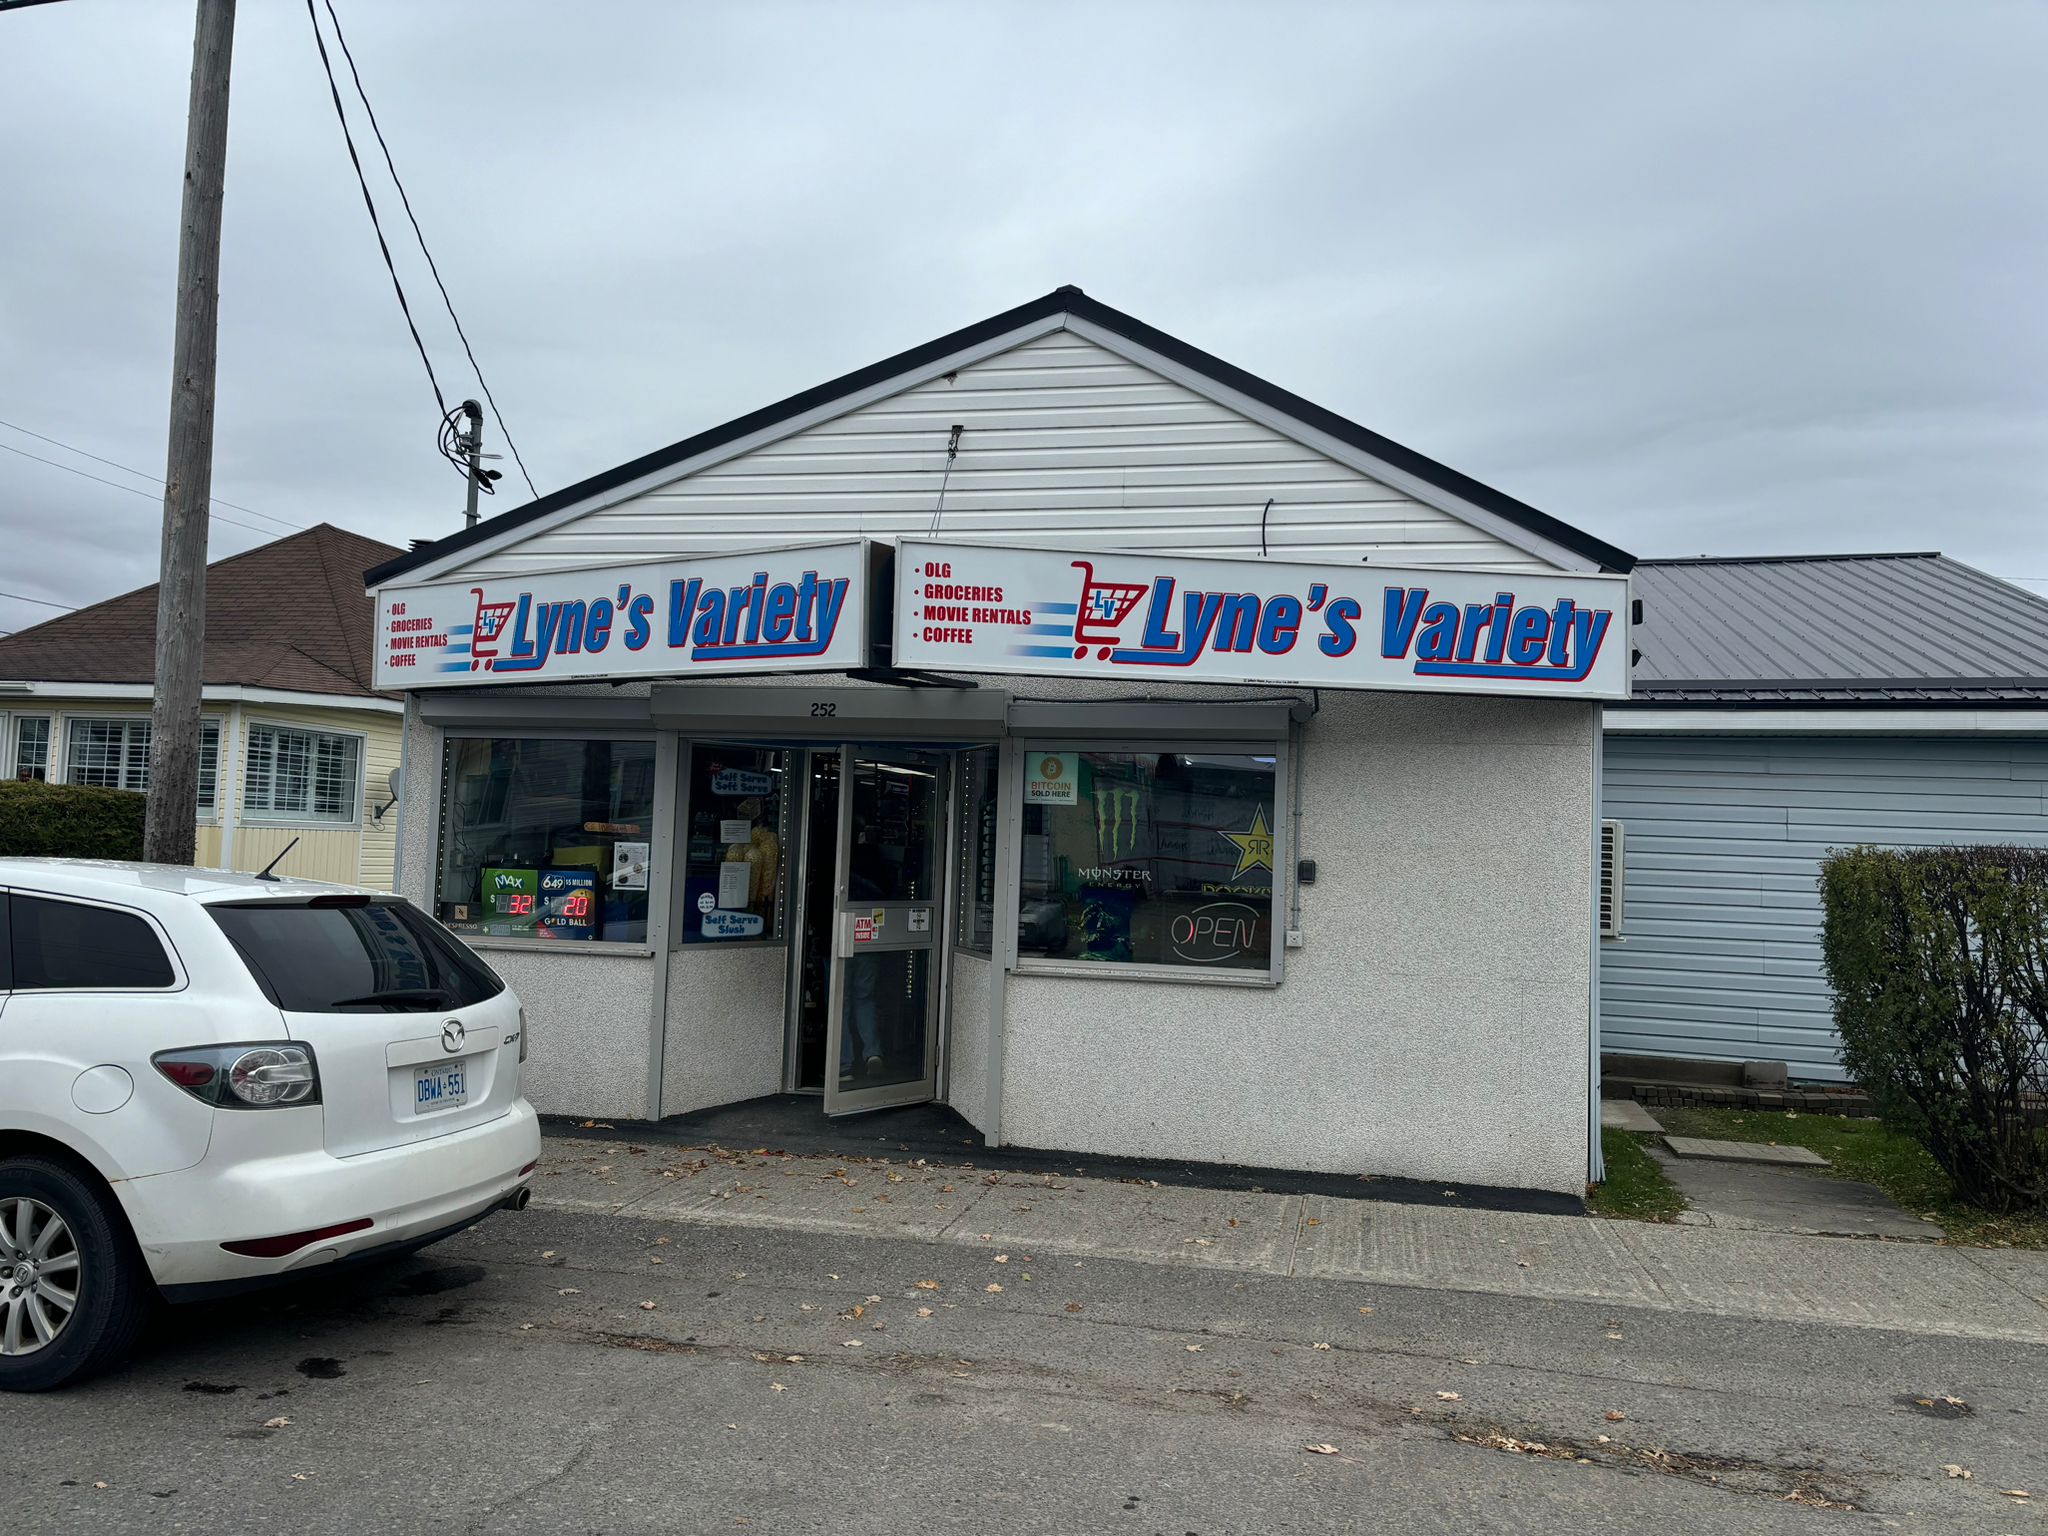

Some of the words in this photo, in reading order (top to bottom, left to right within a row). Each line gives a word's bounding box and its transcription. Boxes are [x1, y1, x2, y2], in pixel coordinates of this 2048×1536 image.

[925, 562, 951, 578] OLG
[924, 584, 1003, 603] GROCERIES
[391, 603, 406, 615] OLG
[923, 605, 969, 622] MOVIE
[972, 608, 1032, 625] RENTALS
[391, 617, 432, 632] GROCERIES
[493, 582, 653, 672] Lyne's
[668, 571, 850, 661] Variety
[923, 627, 972, 644] COFFEE
[1110, 576, 1361, 666] Lyne's
[1381, 587, 1613, 682] Variety
[390, 637, 414, 650] MOVIE
[415, 634, 448, 648] RENTALS
[390, 654, 416, 667] COFFEE
[811, 703, 836, 717] 252
[719, 772, 738, 781] Self
[740, 773, 767, 783] Serve
[715, 781, 738, 791] Soft
[741, 783, 768, 792] Serve
[1031, 782, 1072, 790] BITCOIN
[1078, 866, 1152, 881] MONSTER
[495, 874, 522, 889] MAX
[572, 879, 593, 887] MILLION
[1089, 881, 1141, 889] ENERGY
[510, 894, 530, 914] 32
[563, 896, 589, 916] 20
[569, 919, 587, 927] BALL
[705, 915, 727, 924] Self
[730, 915, 758, 924] Serve
[855, 919, 872, 929] ATM
[718, 925, 745, 934] Slush
[855, 932, 871, 940] INSIDE
[1172, 915, 1256, 948] OPEN
[504, 1032, 520, 1045] CX-7
